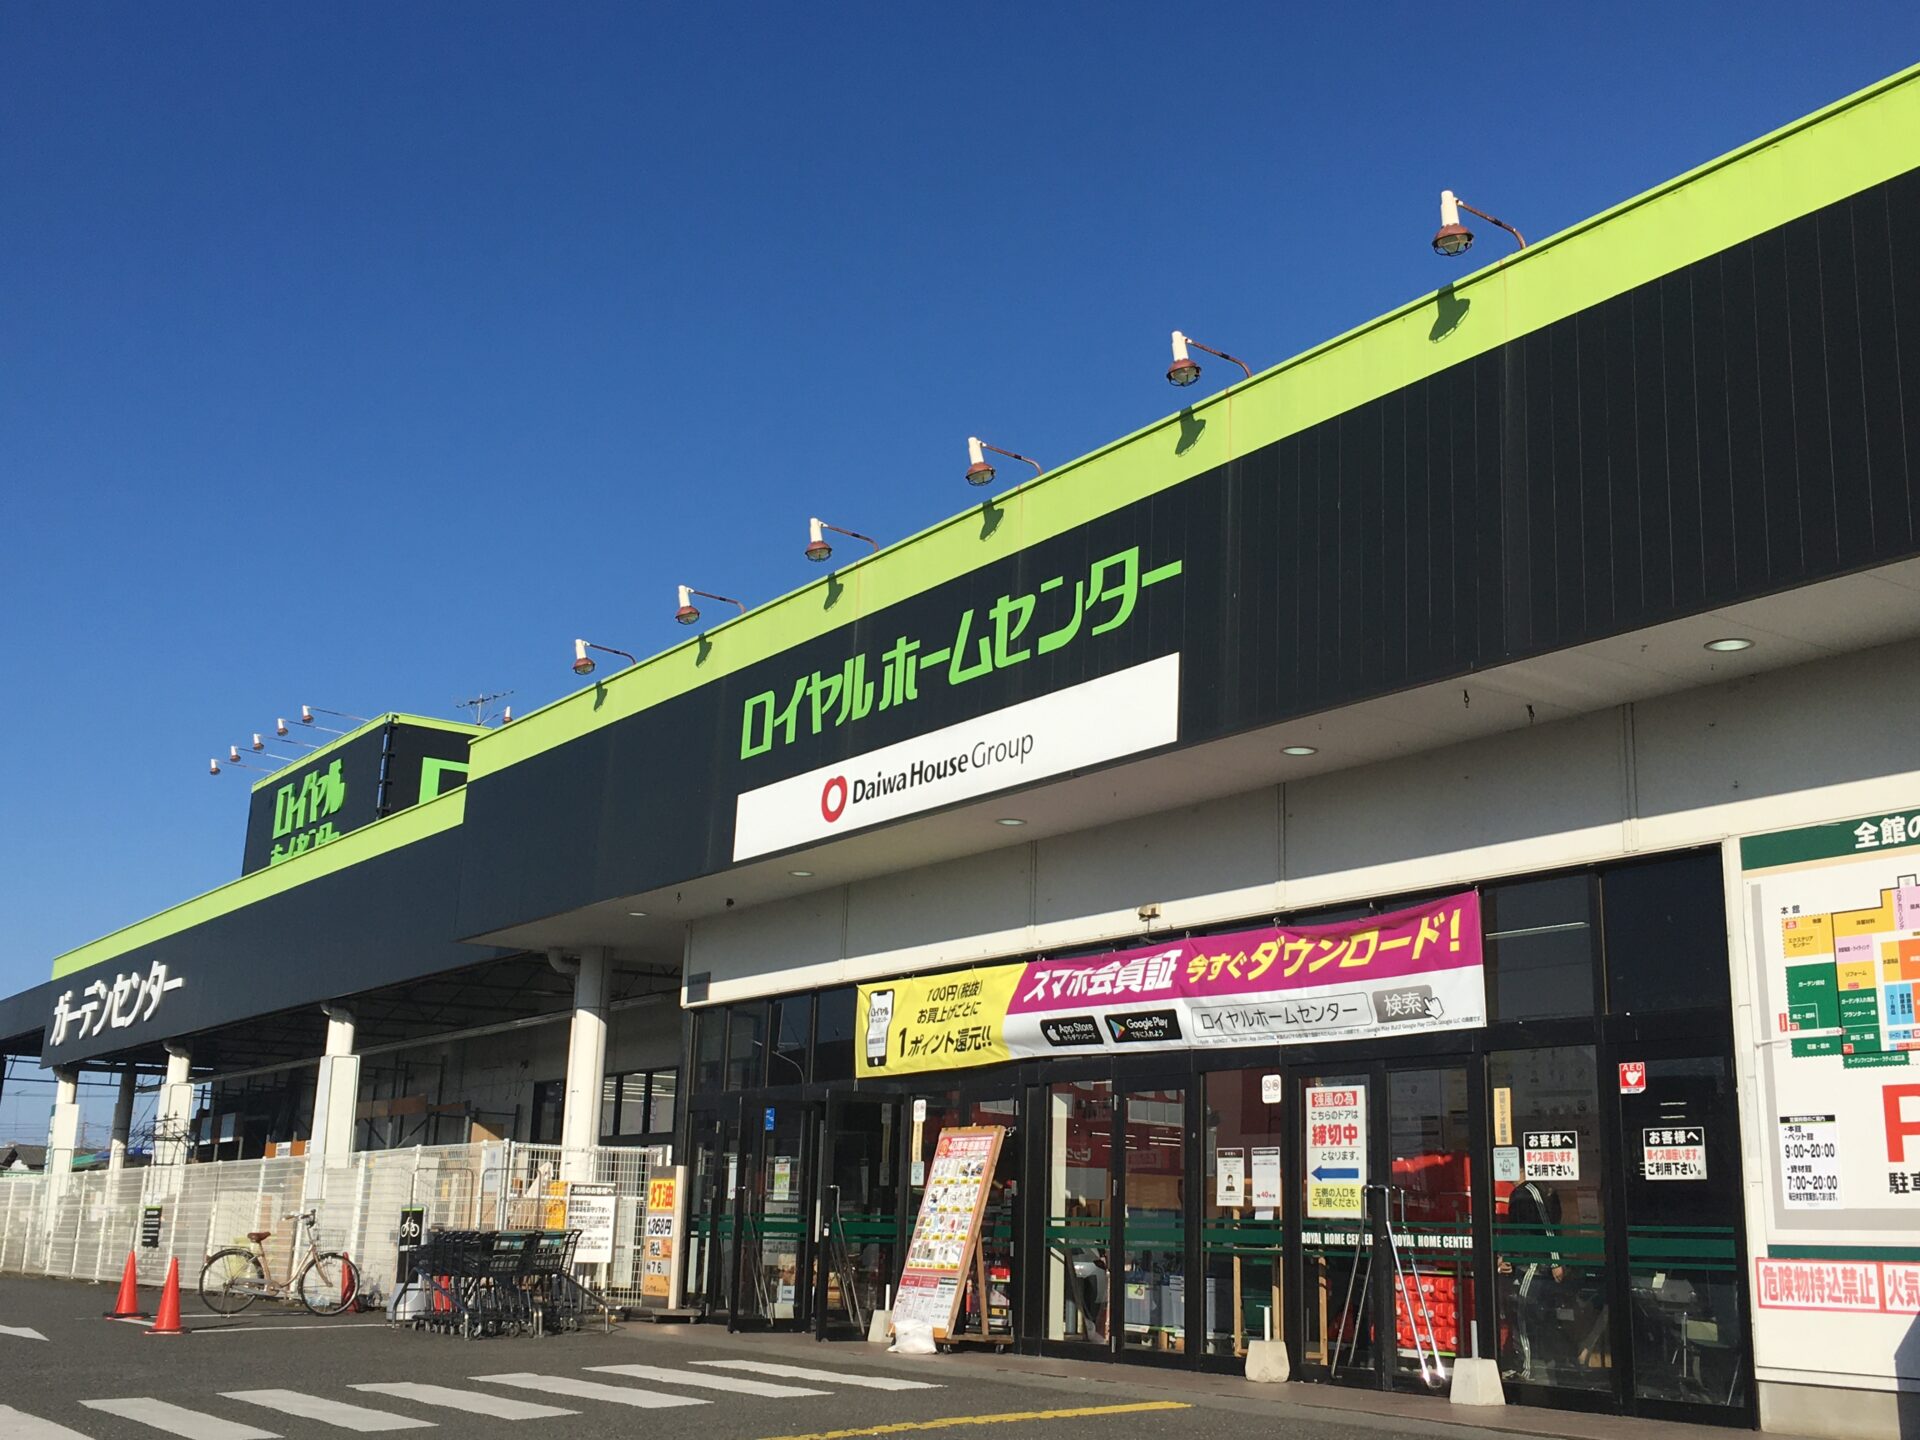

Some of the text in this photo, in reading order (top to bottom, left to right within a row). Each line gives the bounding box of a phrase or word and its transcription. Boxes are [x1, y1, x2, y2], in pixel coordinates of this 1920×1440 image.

[741, 546, 1182, 760] ロイヤルホームセンター
[852, 734, 1034, 804] Daiwa House Group
[273, 758, 345, 840] ロイヤル
[1023, 950, 1182, 1003] スマホ会員証
[50, 960, 183, 1046] ガーデンセンター
[1384, 993, 1421, 1017] 検索
[916, 1001, 982, 1025] お買上げごとに
[1200, 1001, 1358, 1030] ロイヤルホームセンター
[1058, 1022, 1094, 1033] App Store
[1126, 1016, 1168, 1029] Google Play
[1622, 1064, 1643, 1072] AED
[1314, 1091, 1354, 1107] 強風の為
[1311, 1110, 1358, 1120] こちらのドアは
[1312, 1123, 1358, 1146] 締切中
[1528, 1134, 1573, 1147] お客様へ
[1648, 1131, 1699, 1145] お客様へ
[1321, 1151, 1359, 1161] となります。
[650, 1182, 674, 1208] 灯油
[1314, 1187, 1356, 1198] 左側の入口を
[1312, 1197, 1359, 1208] ご利用ください
[1301, 1232, 1373, 1246] ROYAL HOME CENER
[1417, 1235, 1441, 1248] HOME
[1442, 1236, 1473, 1249] CENTER
[1763, 1265, 1876, 1305] 危険物持込禁止
